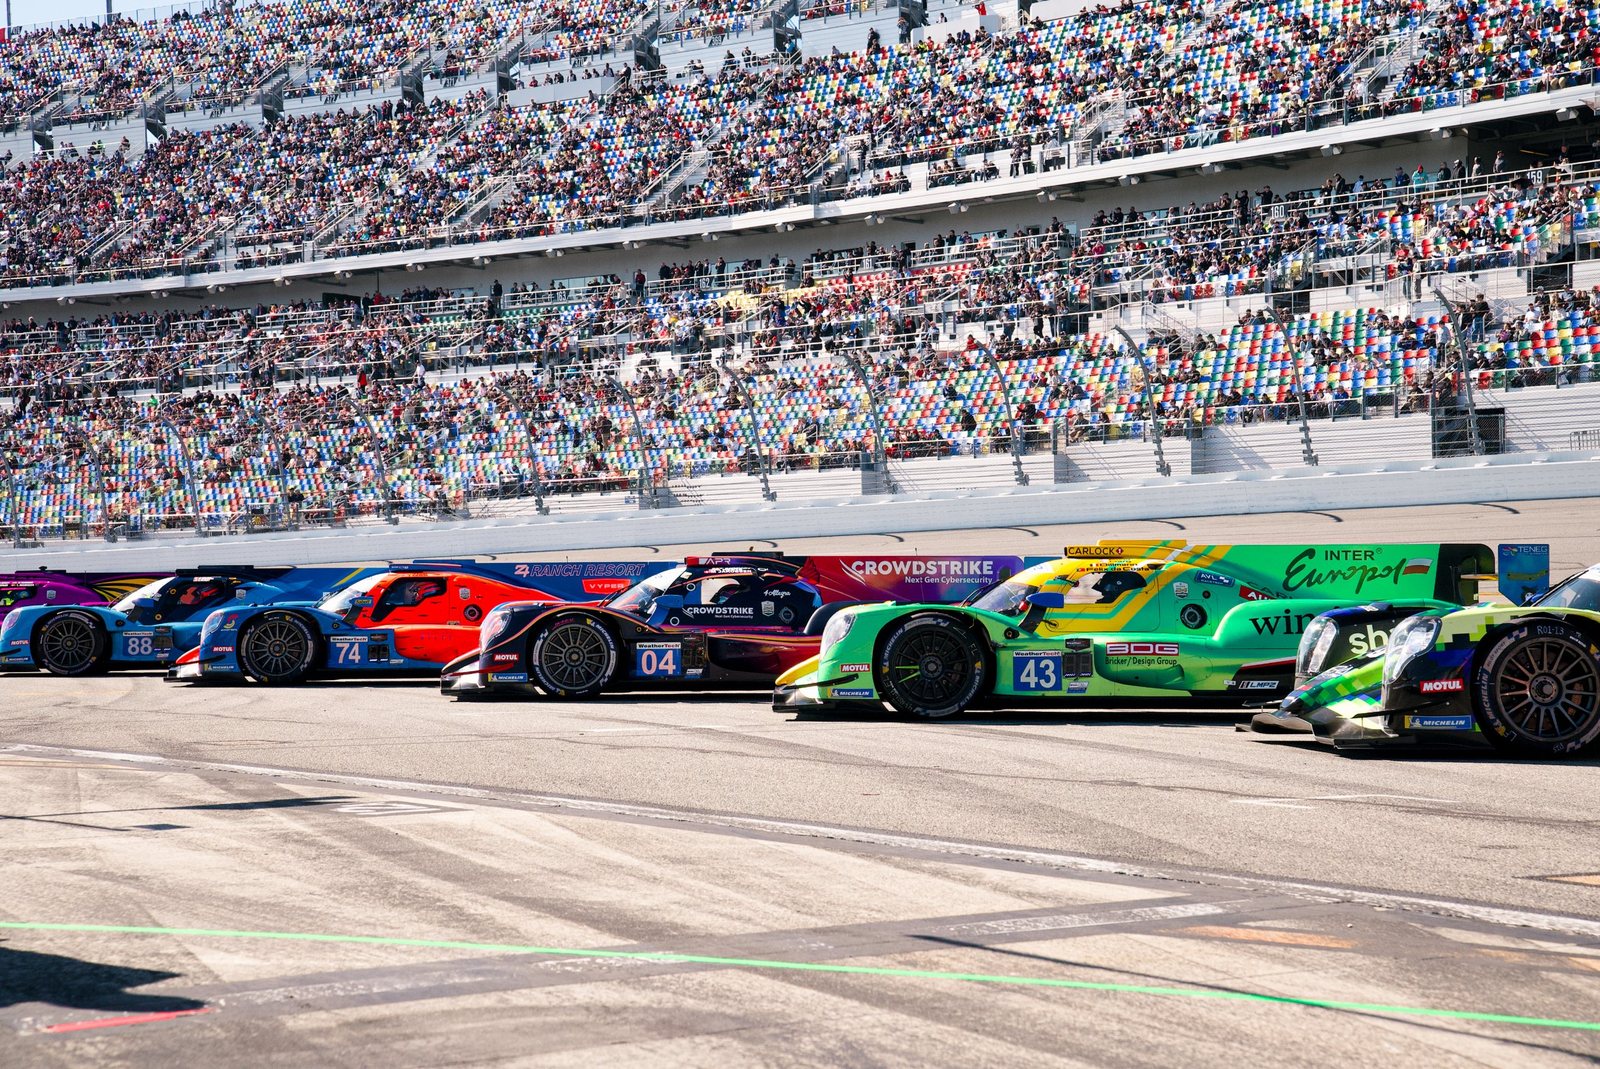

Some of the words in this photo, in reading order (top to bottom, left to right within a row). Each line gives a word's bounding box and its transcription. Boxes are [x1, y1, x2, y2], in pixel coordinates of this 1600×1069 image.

[1526, 170, 1543, 184] 159
[1270, 205, 1285, 218] 160
[862, 258, 872, 270] 161
[699, 277, 710, 289] 162
[1068, 546, 1115, 556] CARLOCK
[1324, 549, 1375, 561] INTER
[1518, 545, 1548, 553] TENEG
[530, 564, 583, 577] RANCH
[584, 563, 646, 577] RESORT
[851, 560, 994, 576] CROWDSTRIKE
[1282, 547, 1407, 595] Europol
[904, 576, 923, 584] Next
[924, 576, 940, 584] Gen
[940, 576, 993, 585] Cybersecurity
[1200, 573, 1218, 581] AVL
[688, 607, 754, 615] CROWDSTRIKE
[1249, 606, 1339, 635] win
[594, 622, 616, 650] MICHELIN
[1348, 624, 1394, 656] sh
[127, 637, 153, 656] 88
[883, 627, 904, 661] MICHELIN
[1107, 643, 1178, 655] BDG
[335, 642, 361, 664] 74
[641, 649, 677, 675] 04
[1156, 656, 1178, 666] Group
[841, 664, 870, 672] MOTUL
[1020, 658, 1057, 688] 43
[1422, 681, 1463, 692] MOTUL
[1481, 671, 1497, 720] MICHELIN
